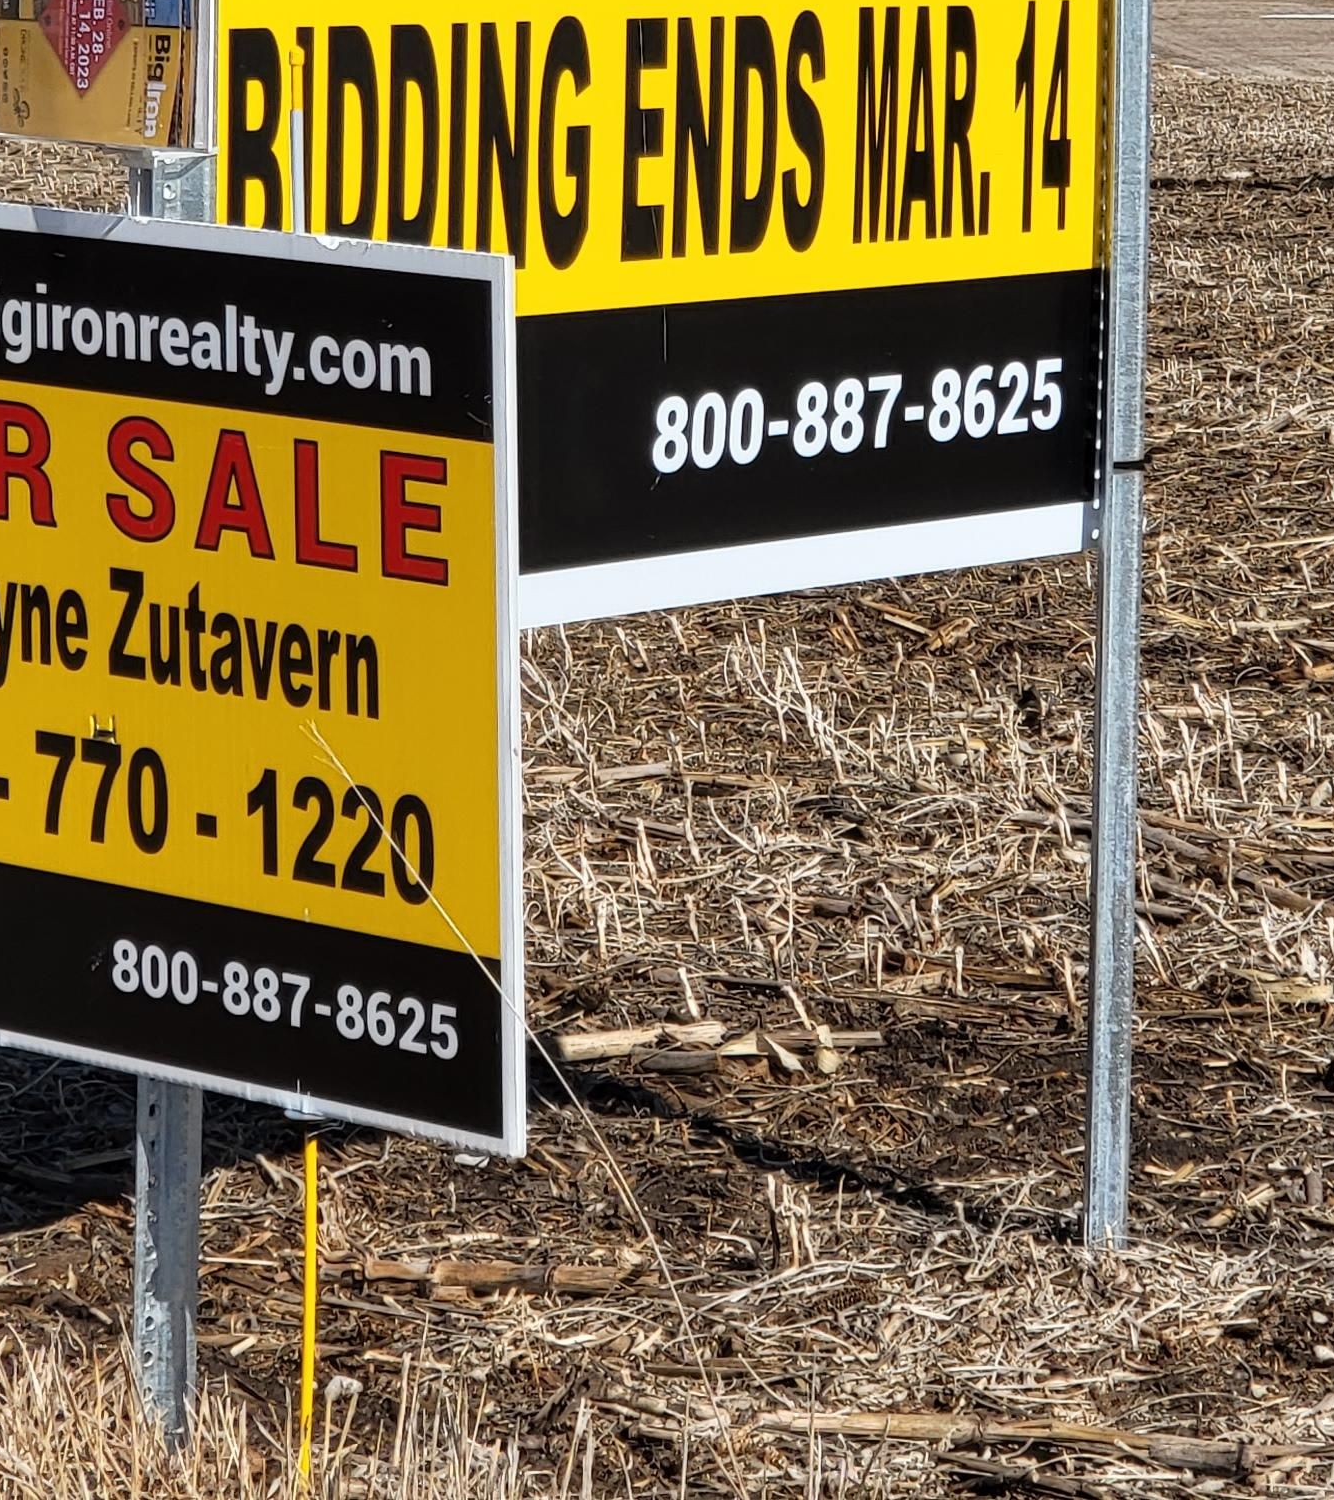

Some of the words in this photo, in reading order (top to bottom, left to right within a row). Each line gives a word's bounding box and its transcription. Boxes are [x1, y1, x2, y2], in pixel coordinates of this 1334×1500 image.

[76, 12, 91, 38] 14,
[77, 44, 90, 90] 2023
[91, 31, 104, 63] 28-
[227, 16, 590, 270] BIDDING
[621, 10, 826, 262] ENDS
[853, 5, 990, 243] MAR.
[1015, 0, 1071, 232] 14
[651, 357, 1063, 474] 800-887-8625
[106, 415, 450, 587] SALE
[109, 566, 379, 720] Zutavern
[35, 728, 169, 855] 770
[247, 768, 435, 905] 1220
[111, 939, 460, 1062] 800-887-8625
